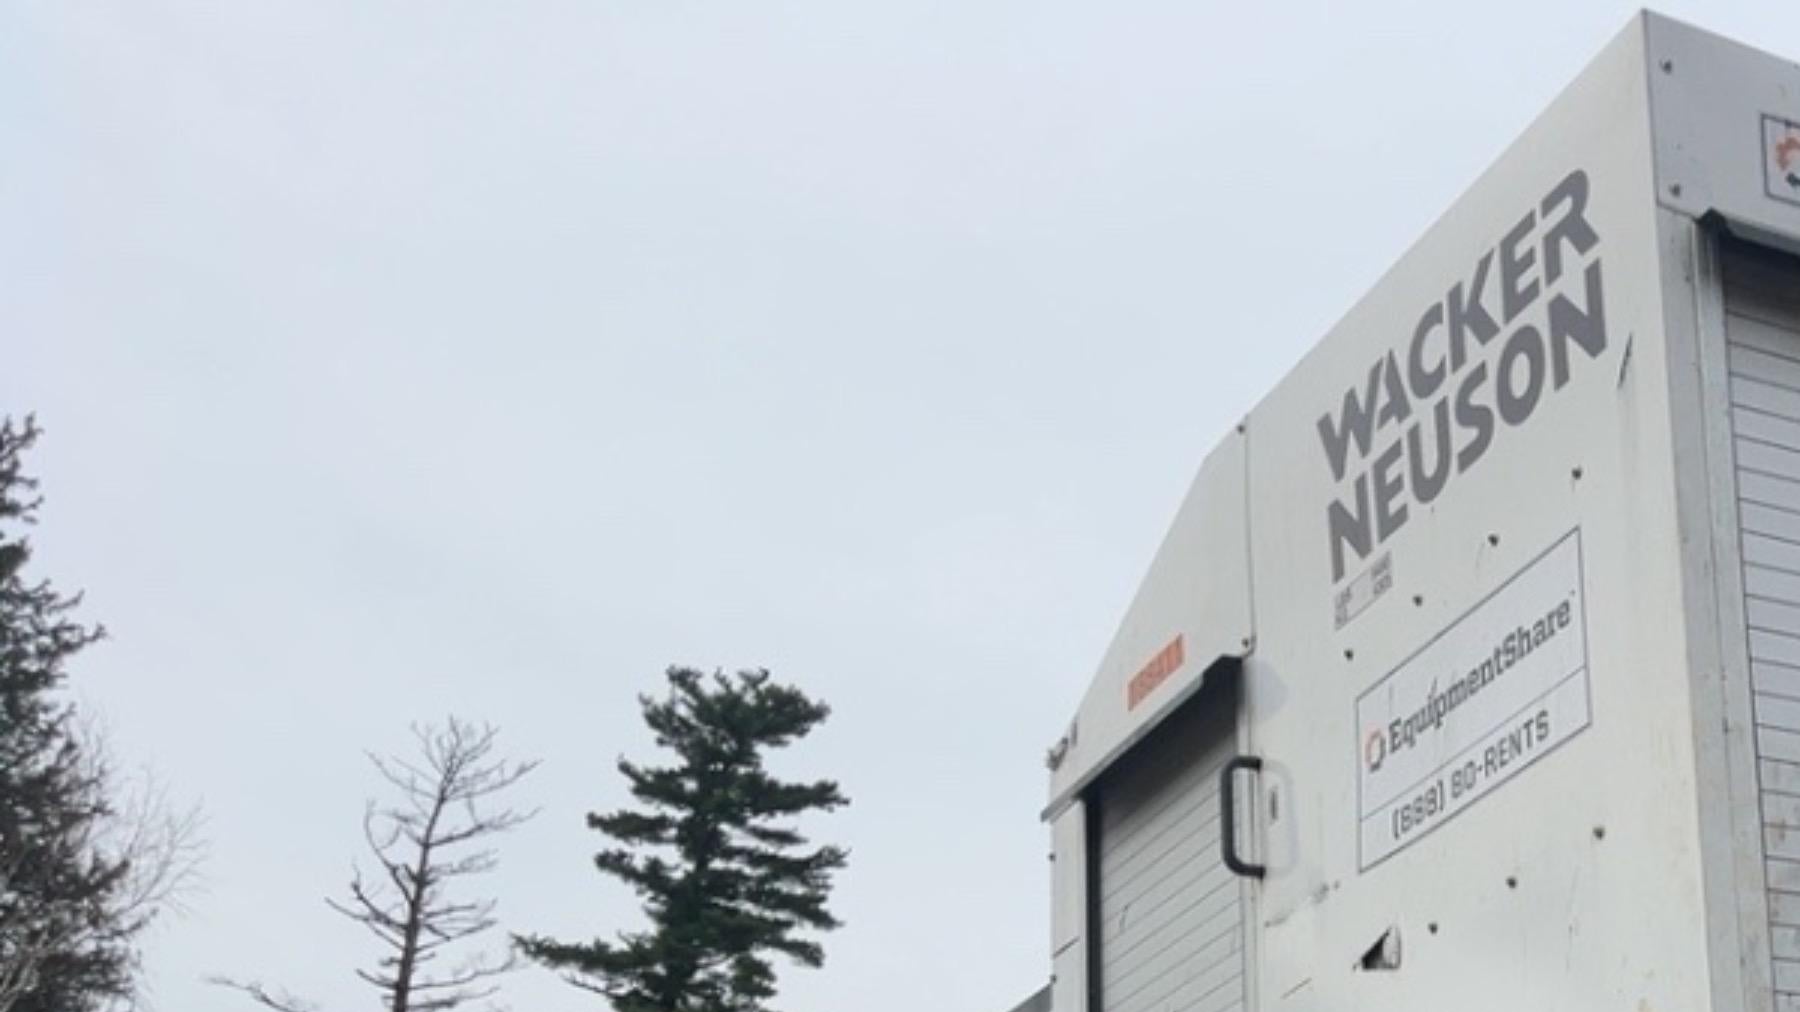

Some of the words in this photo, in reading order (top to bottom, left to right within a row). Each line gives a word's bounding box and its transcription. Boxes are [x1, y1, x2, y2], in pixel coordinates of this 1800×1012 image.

[1316, 168, 1600, 482] WACKER
[1326, 255, 1607, 584] NEUSON
[1387, 599, 1571, 755] EquipmentShare
[1391, 779, 1445, 840] (888)
[1450, 709, 1550, 799] 80-RENTS
